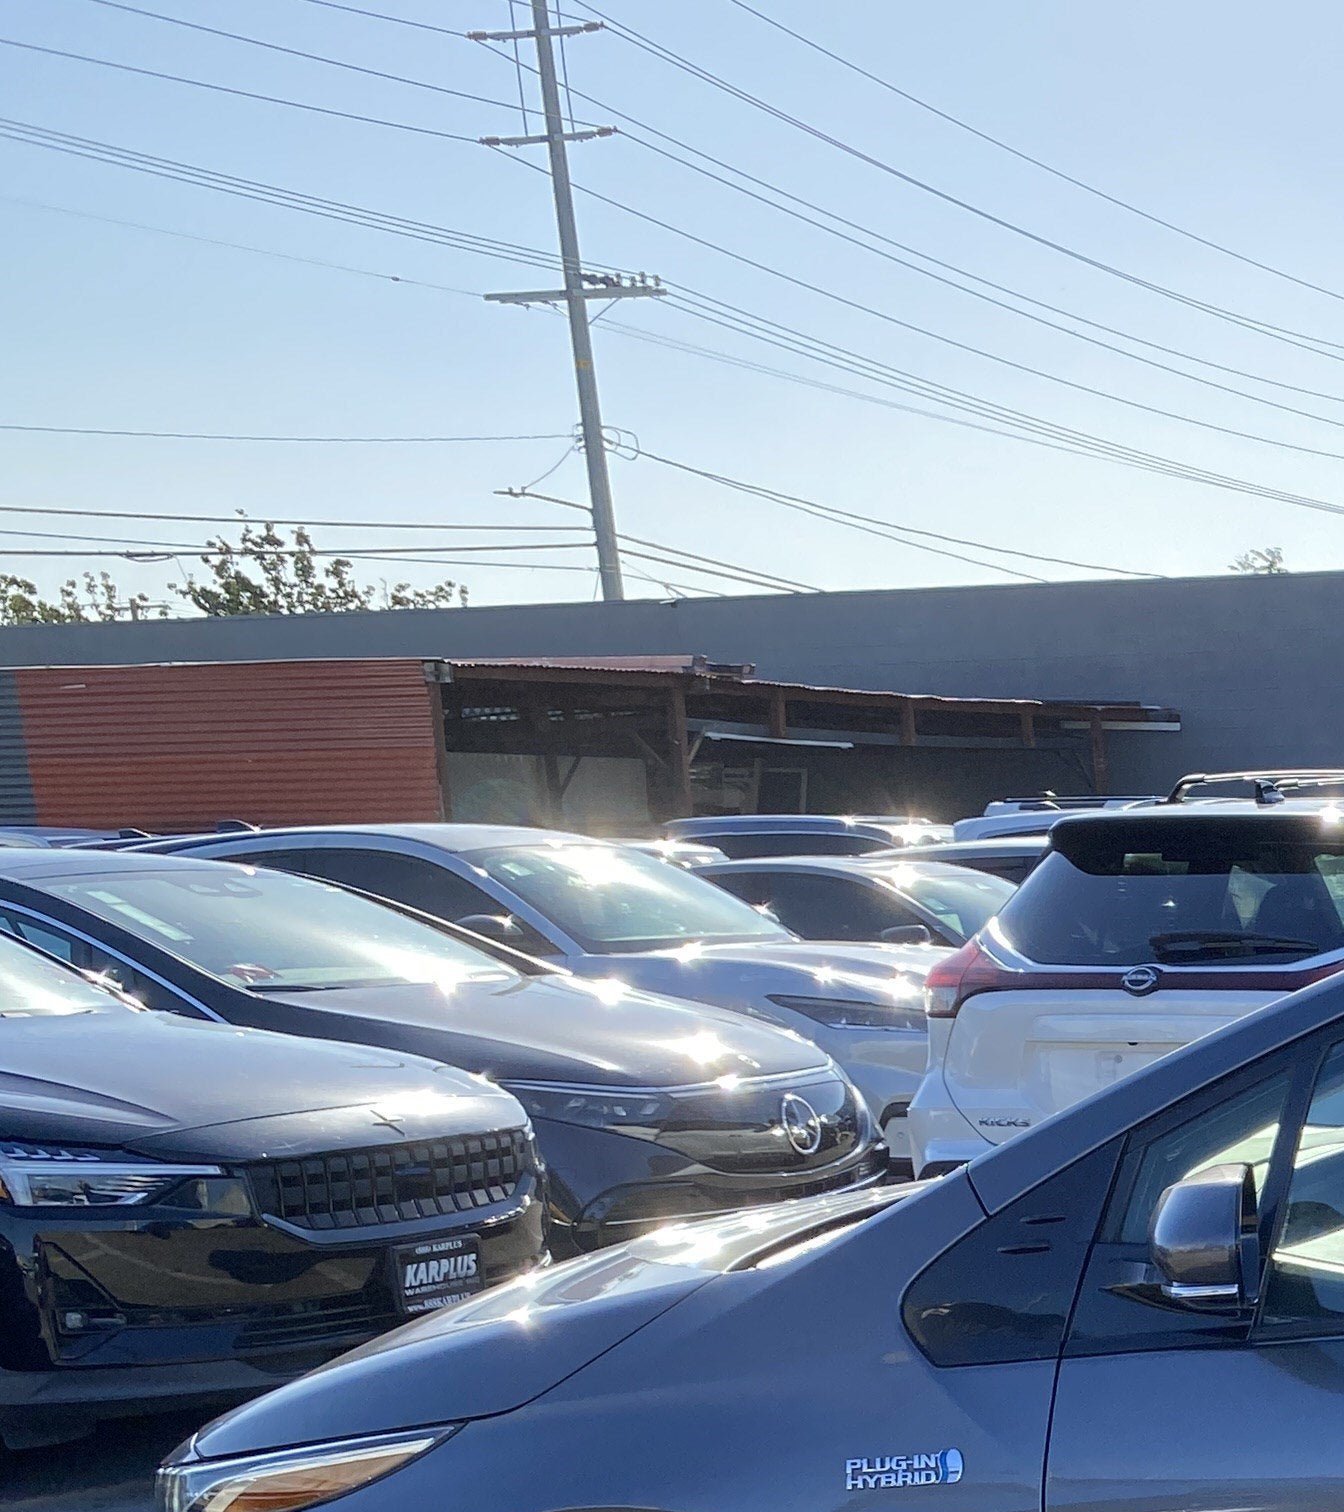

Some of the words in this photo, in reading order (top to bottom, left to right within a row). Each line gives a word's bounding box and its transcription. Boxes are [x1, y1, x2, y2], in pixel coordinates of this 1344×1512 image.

[405, 1253, 477, 1288] KARPLUS
[846, 1453, 938, 1474] PLUG-IN
[846, 1470, 937, 1490] HYBRID
